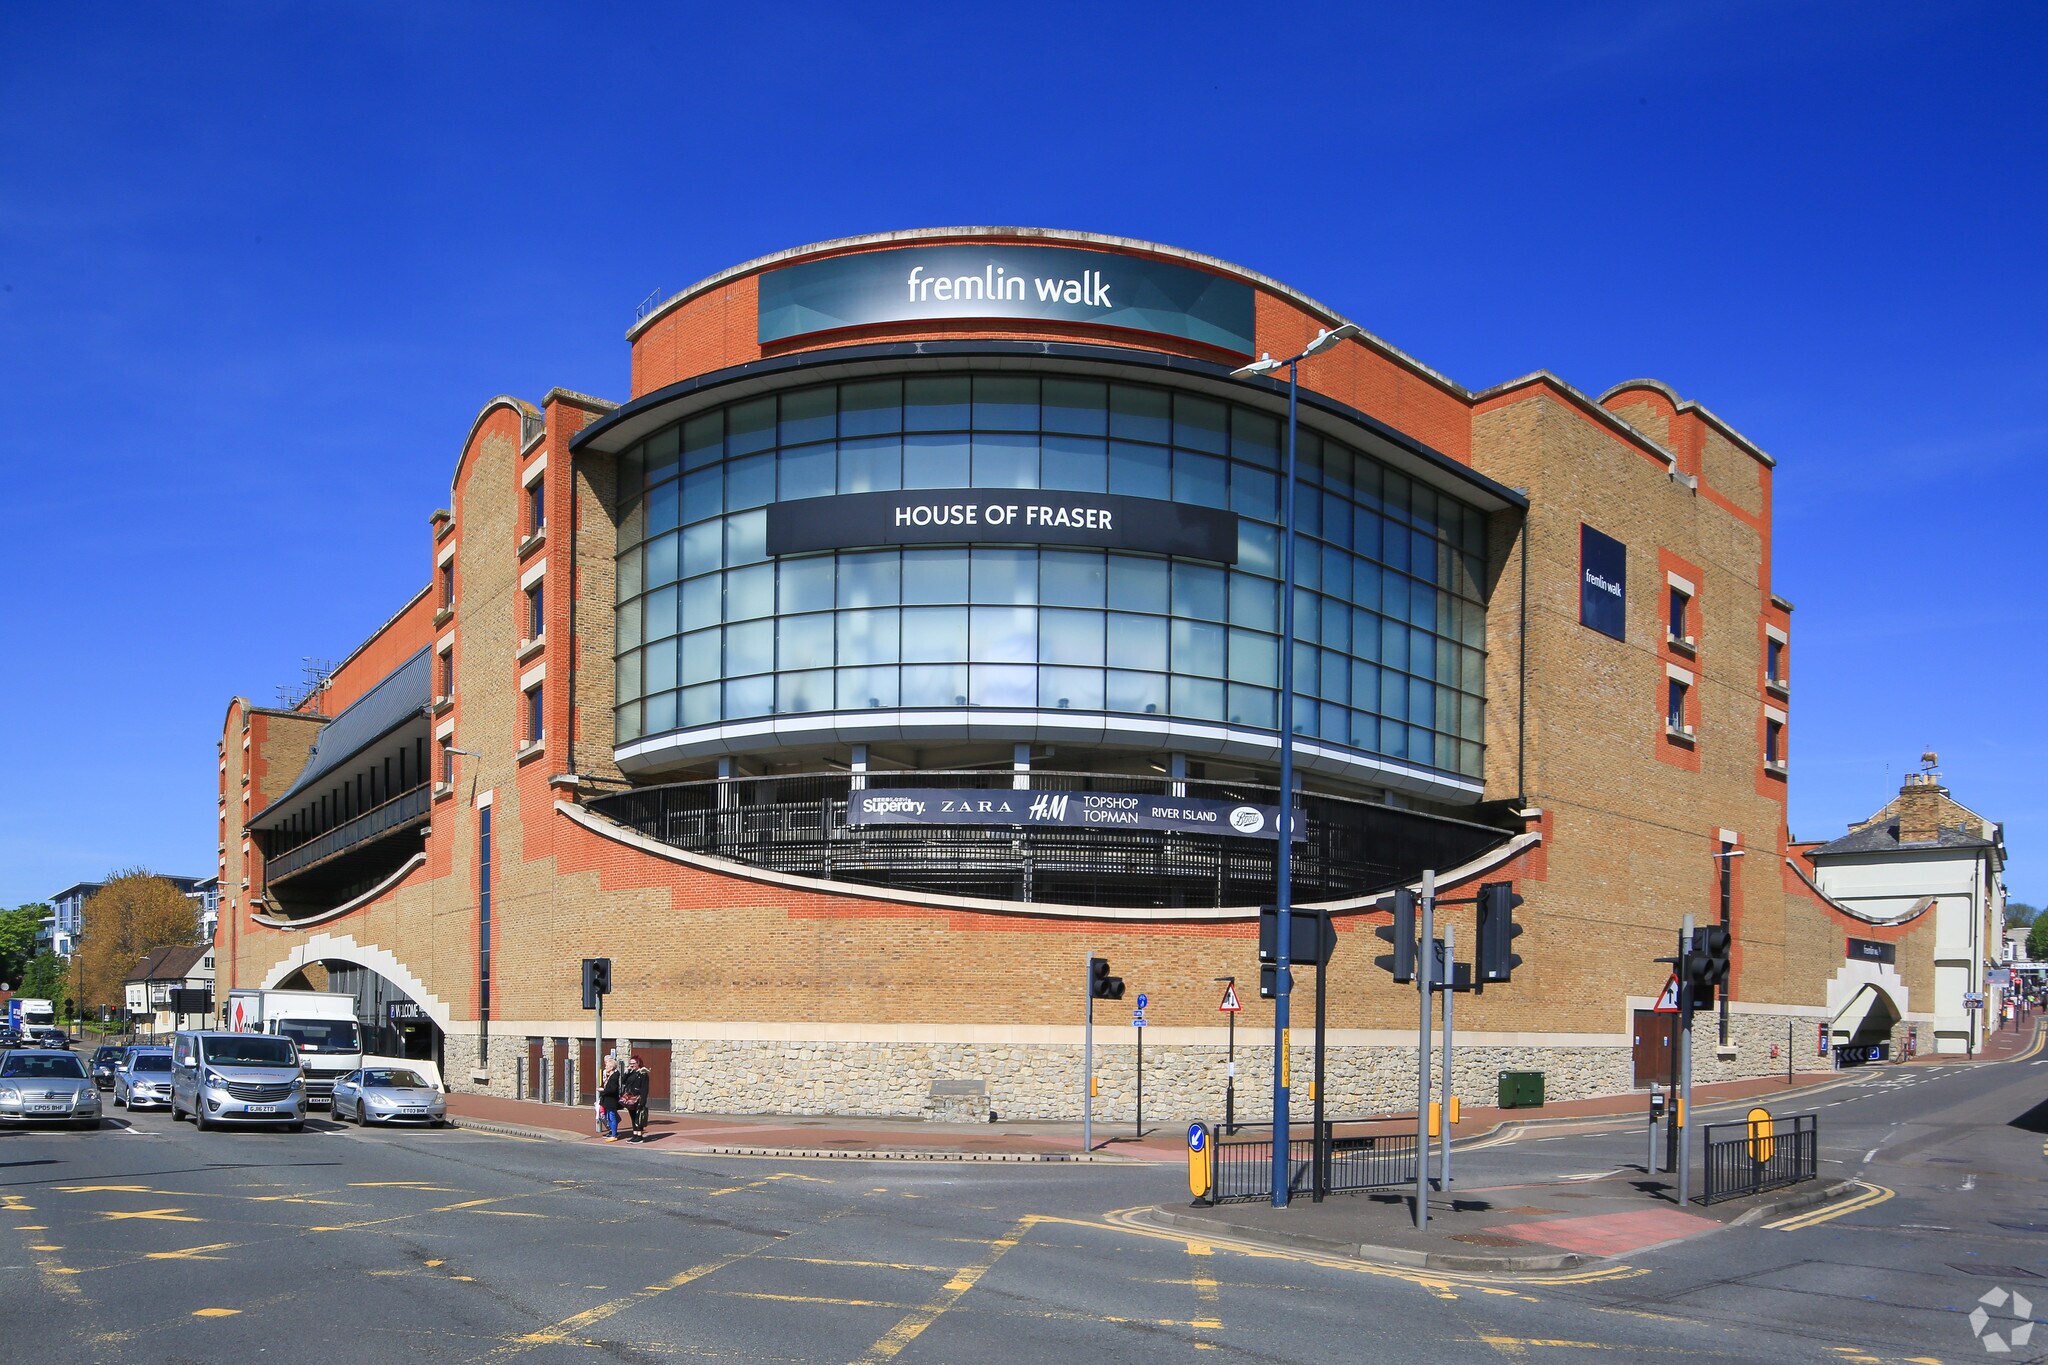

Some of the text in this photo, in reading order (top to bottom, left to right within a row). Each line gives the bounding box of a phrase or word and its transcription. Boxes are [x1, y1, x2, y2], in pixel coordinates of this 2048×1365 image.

[907, 264, 1113, 308] fremlin walk
[895, 505, 1113, 530] HOUSE OF FRASER
[1586, 568, 1621, 597] fremlin walk
[941, 801, 1014, 813] ZARA
[1029, 794, 1069, 822] H&M
[1083, 796, 1139, 810] TOPSHOP
[1083, 810, 1139, 824] TOPMAN
[1152, 807, 1217, 822] RIVER ISLAND
